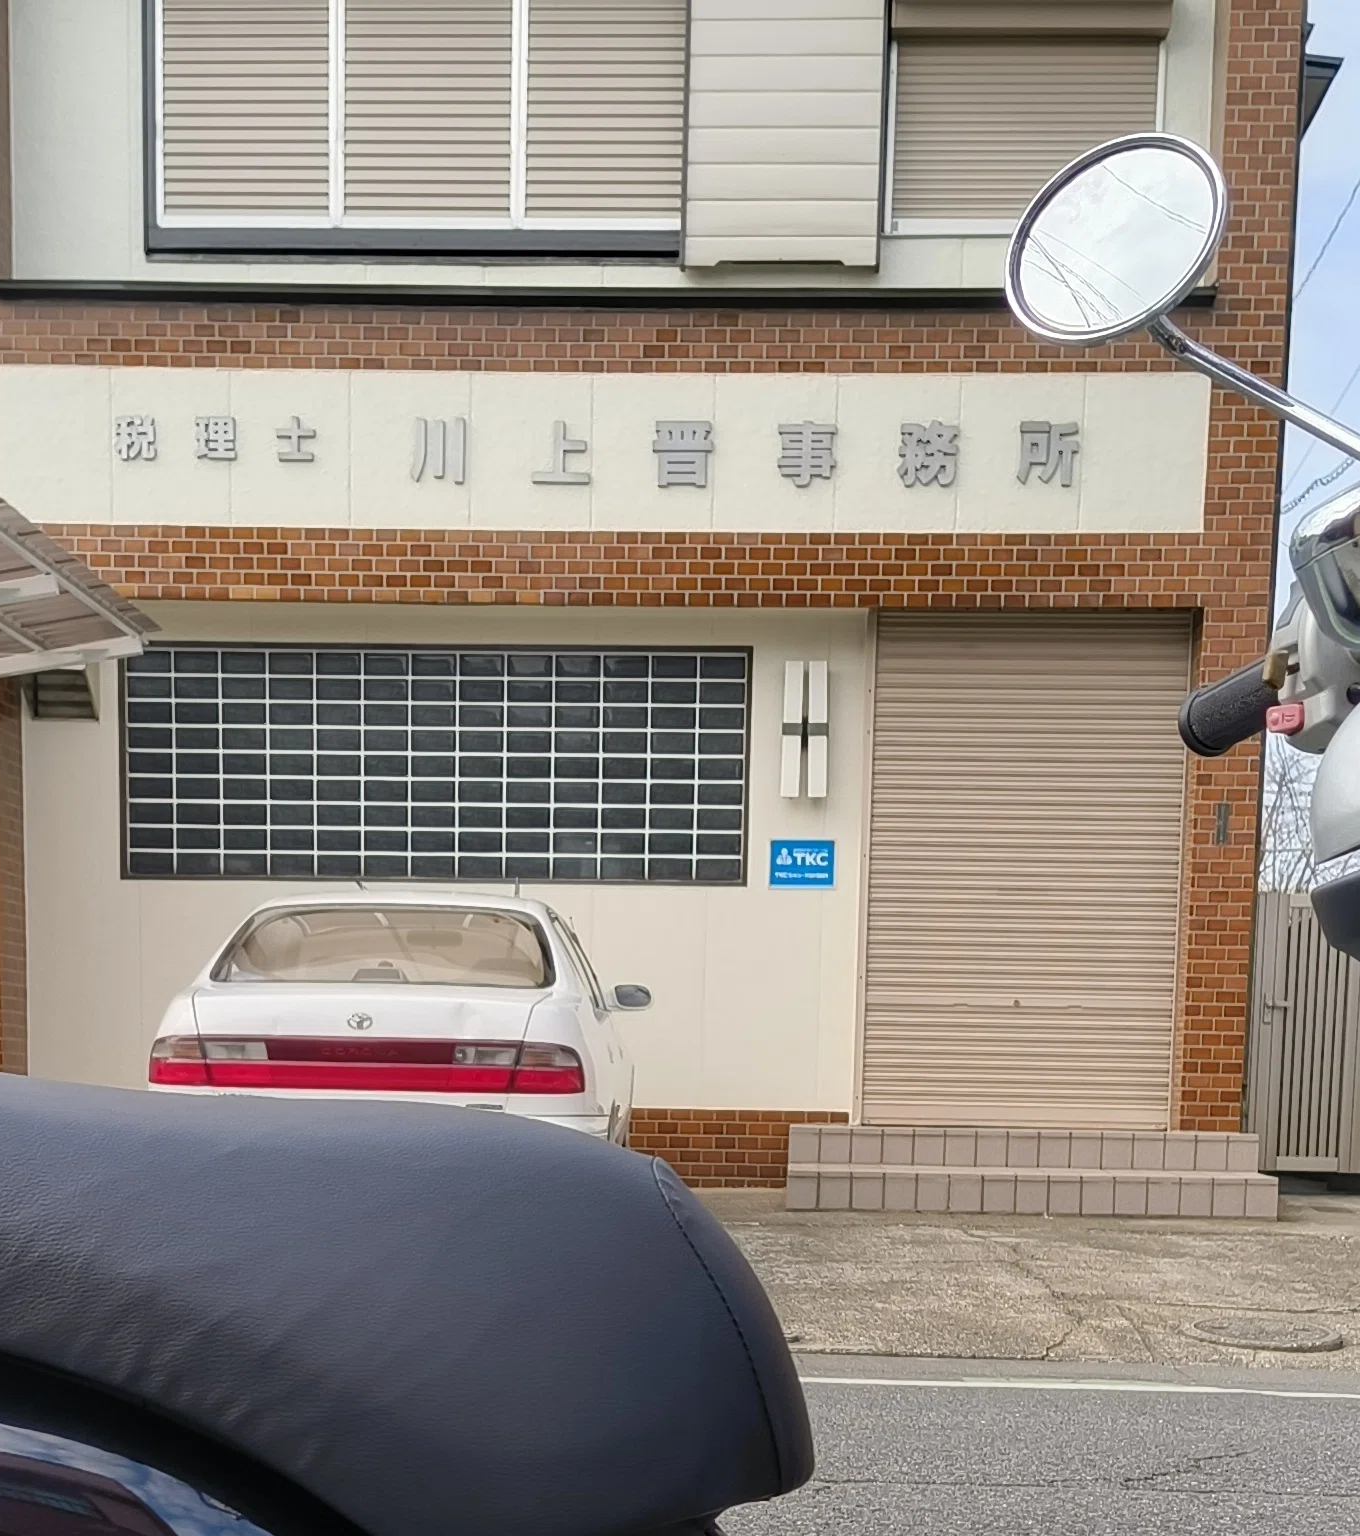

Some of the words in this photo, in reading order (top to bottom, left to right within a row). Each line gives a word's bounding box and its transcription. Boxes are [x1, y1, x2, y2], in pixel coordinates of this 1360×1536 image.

[114, 415, 317, 462] 税理士
[409, 416, 1080, 488] 川上晋事務所
[793, 852, 829, 867] TKC
